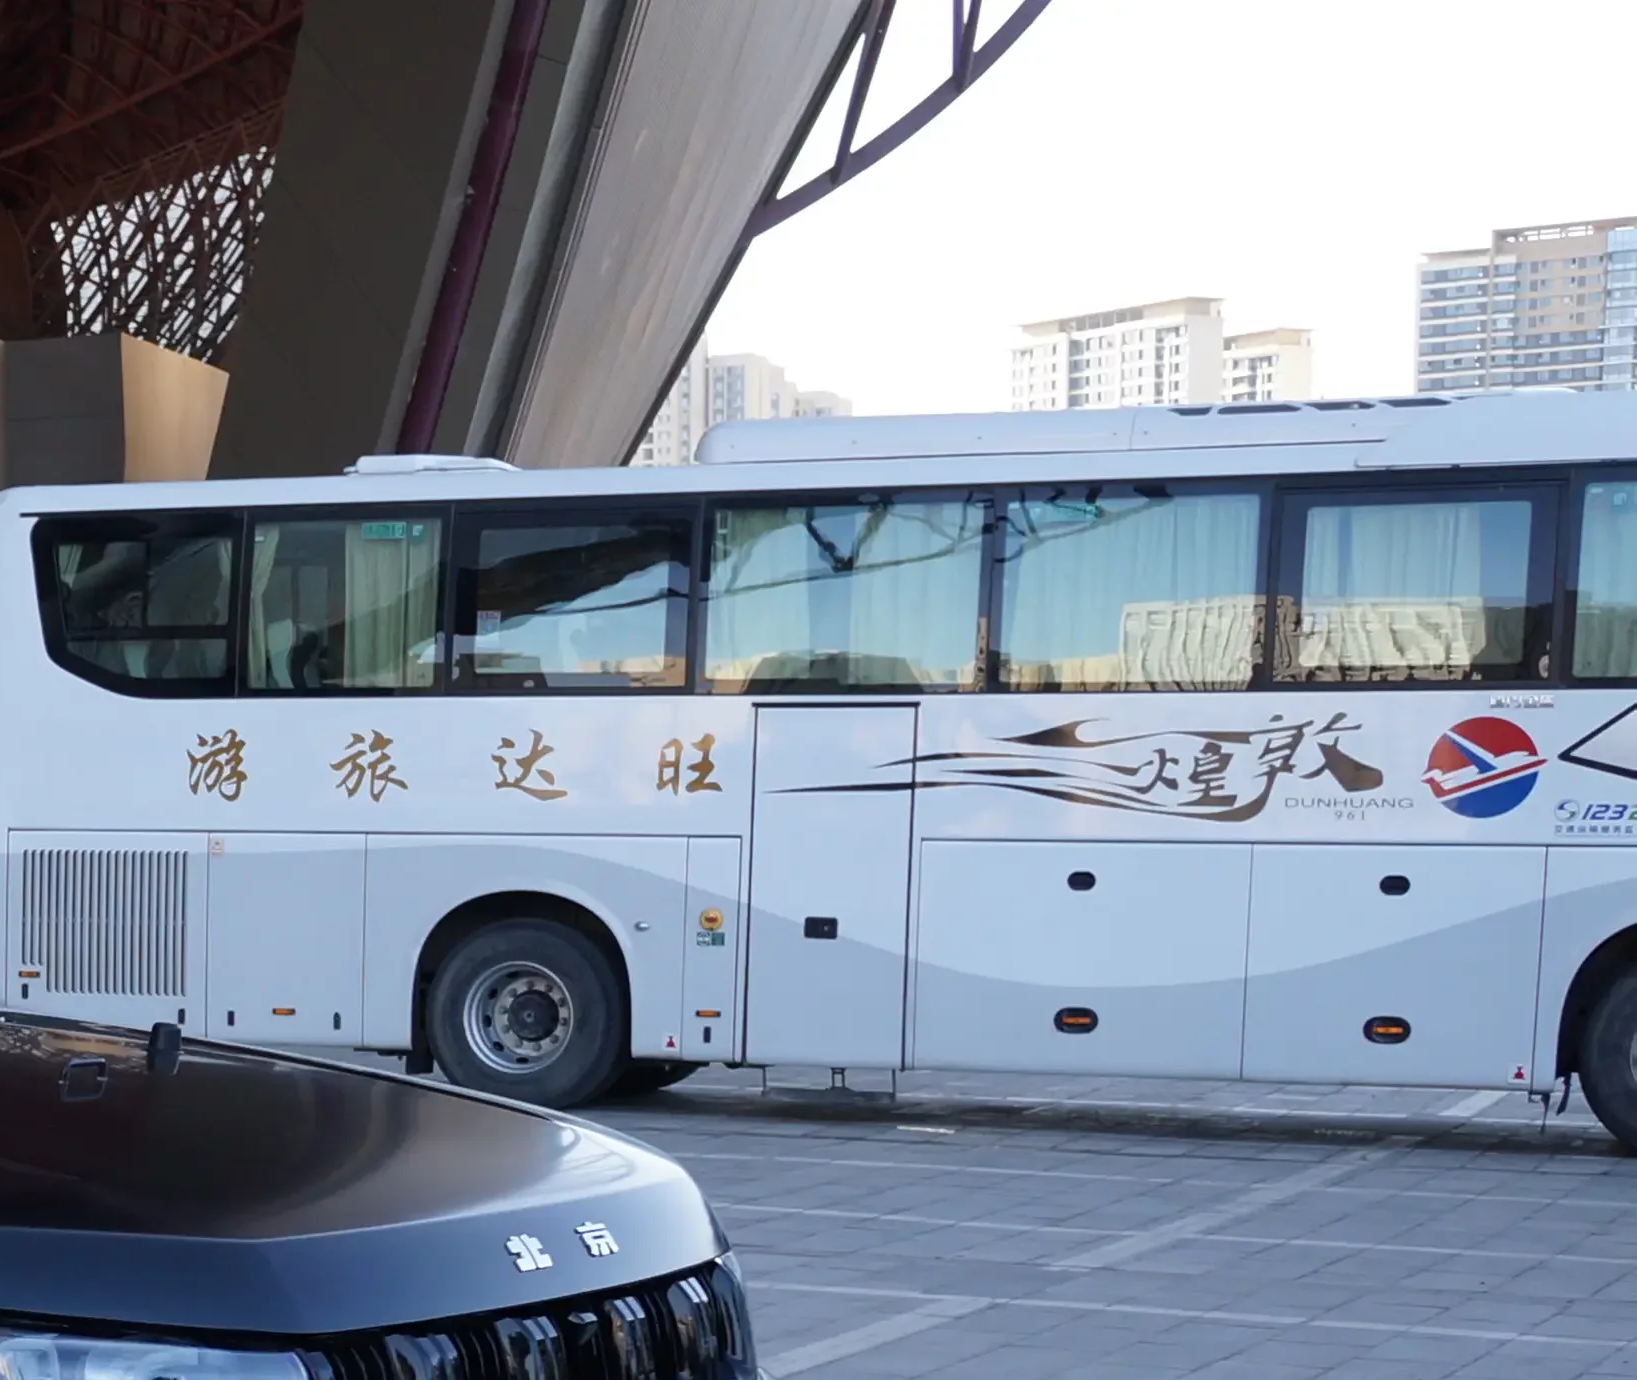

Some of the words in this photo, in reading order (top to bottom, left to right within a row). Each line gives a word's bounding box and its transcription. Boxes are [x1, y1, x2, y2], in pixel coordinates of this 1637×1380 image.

[1284, 797, 1414, 809] DUNHUANG
[1334, 811, 1366, 822] 961
[504, 1220, 620, 1273] 北京
